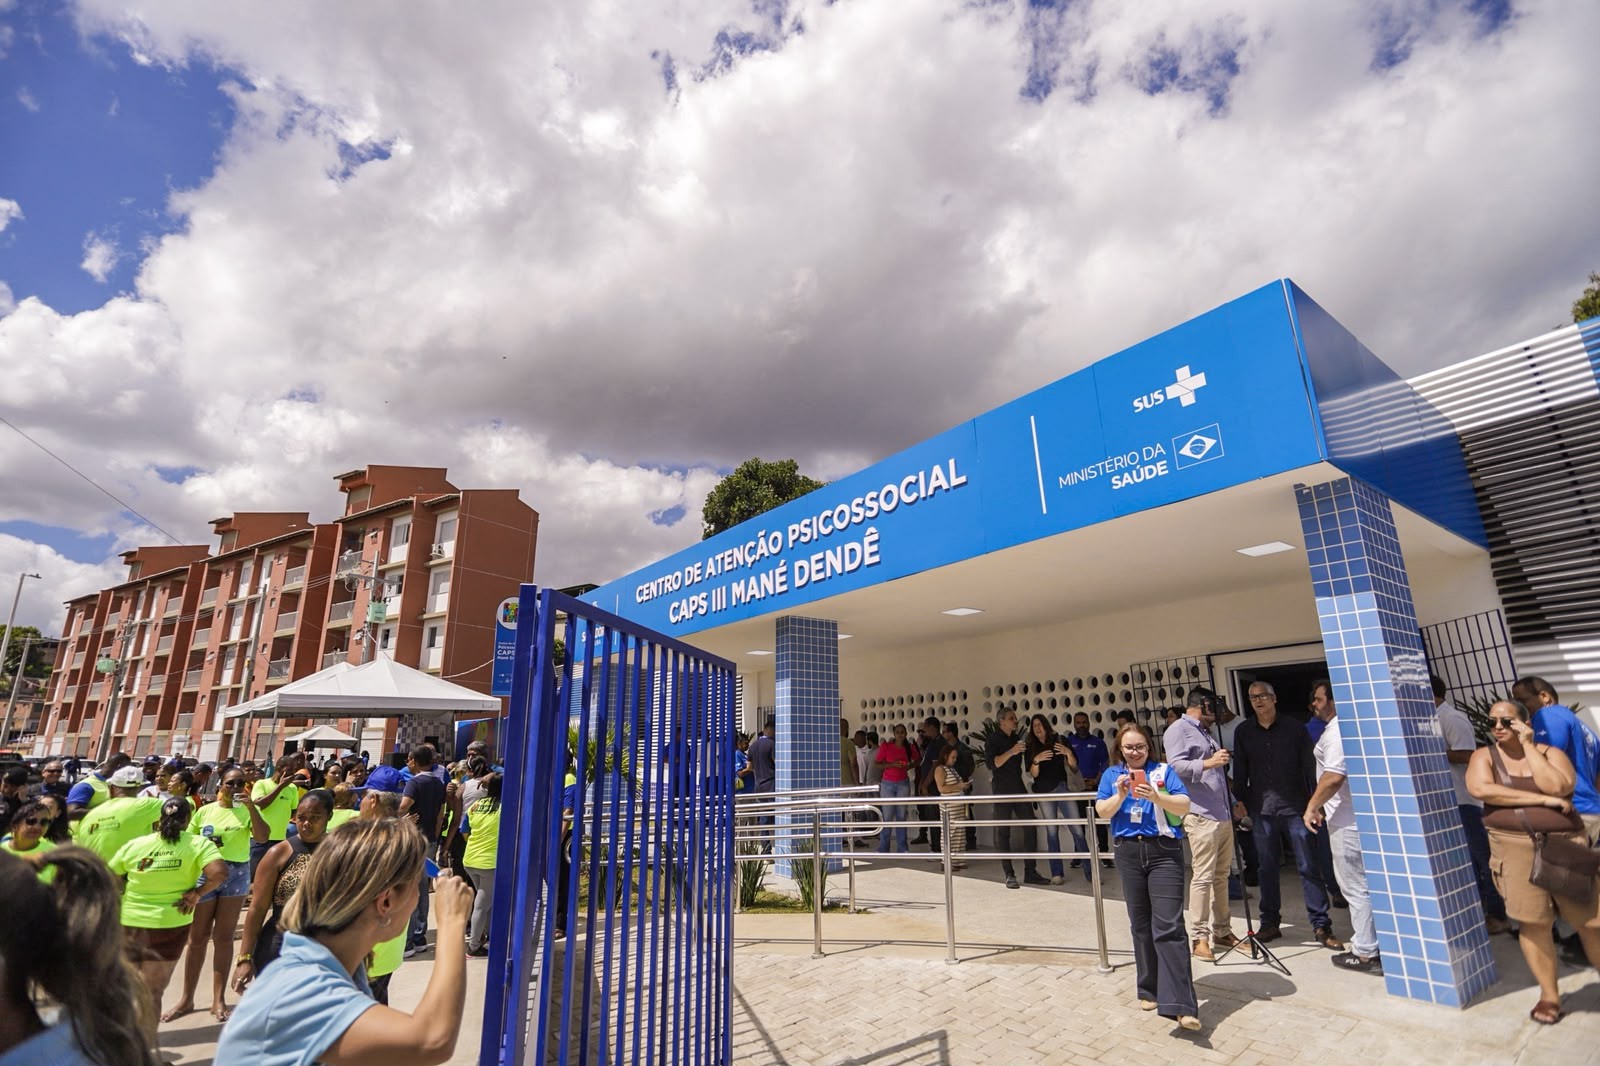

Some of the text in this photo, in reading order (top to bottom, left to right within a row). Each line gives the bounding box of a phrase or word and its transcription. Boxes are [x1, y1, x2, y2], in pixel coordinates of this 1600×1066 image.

[1132, 389, 1165, 413] SUS
[1058, 443, 1167, 489] MINISTÉRIO DA
[1110, 460, 1169, 489] SAÚDE
[635, 458, 967, 604] CENTRO DE ATENÇÃO PSICOSSOCIAL
[669, 526, 881, 625] CAPS III MANÉ DENDÊ
